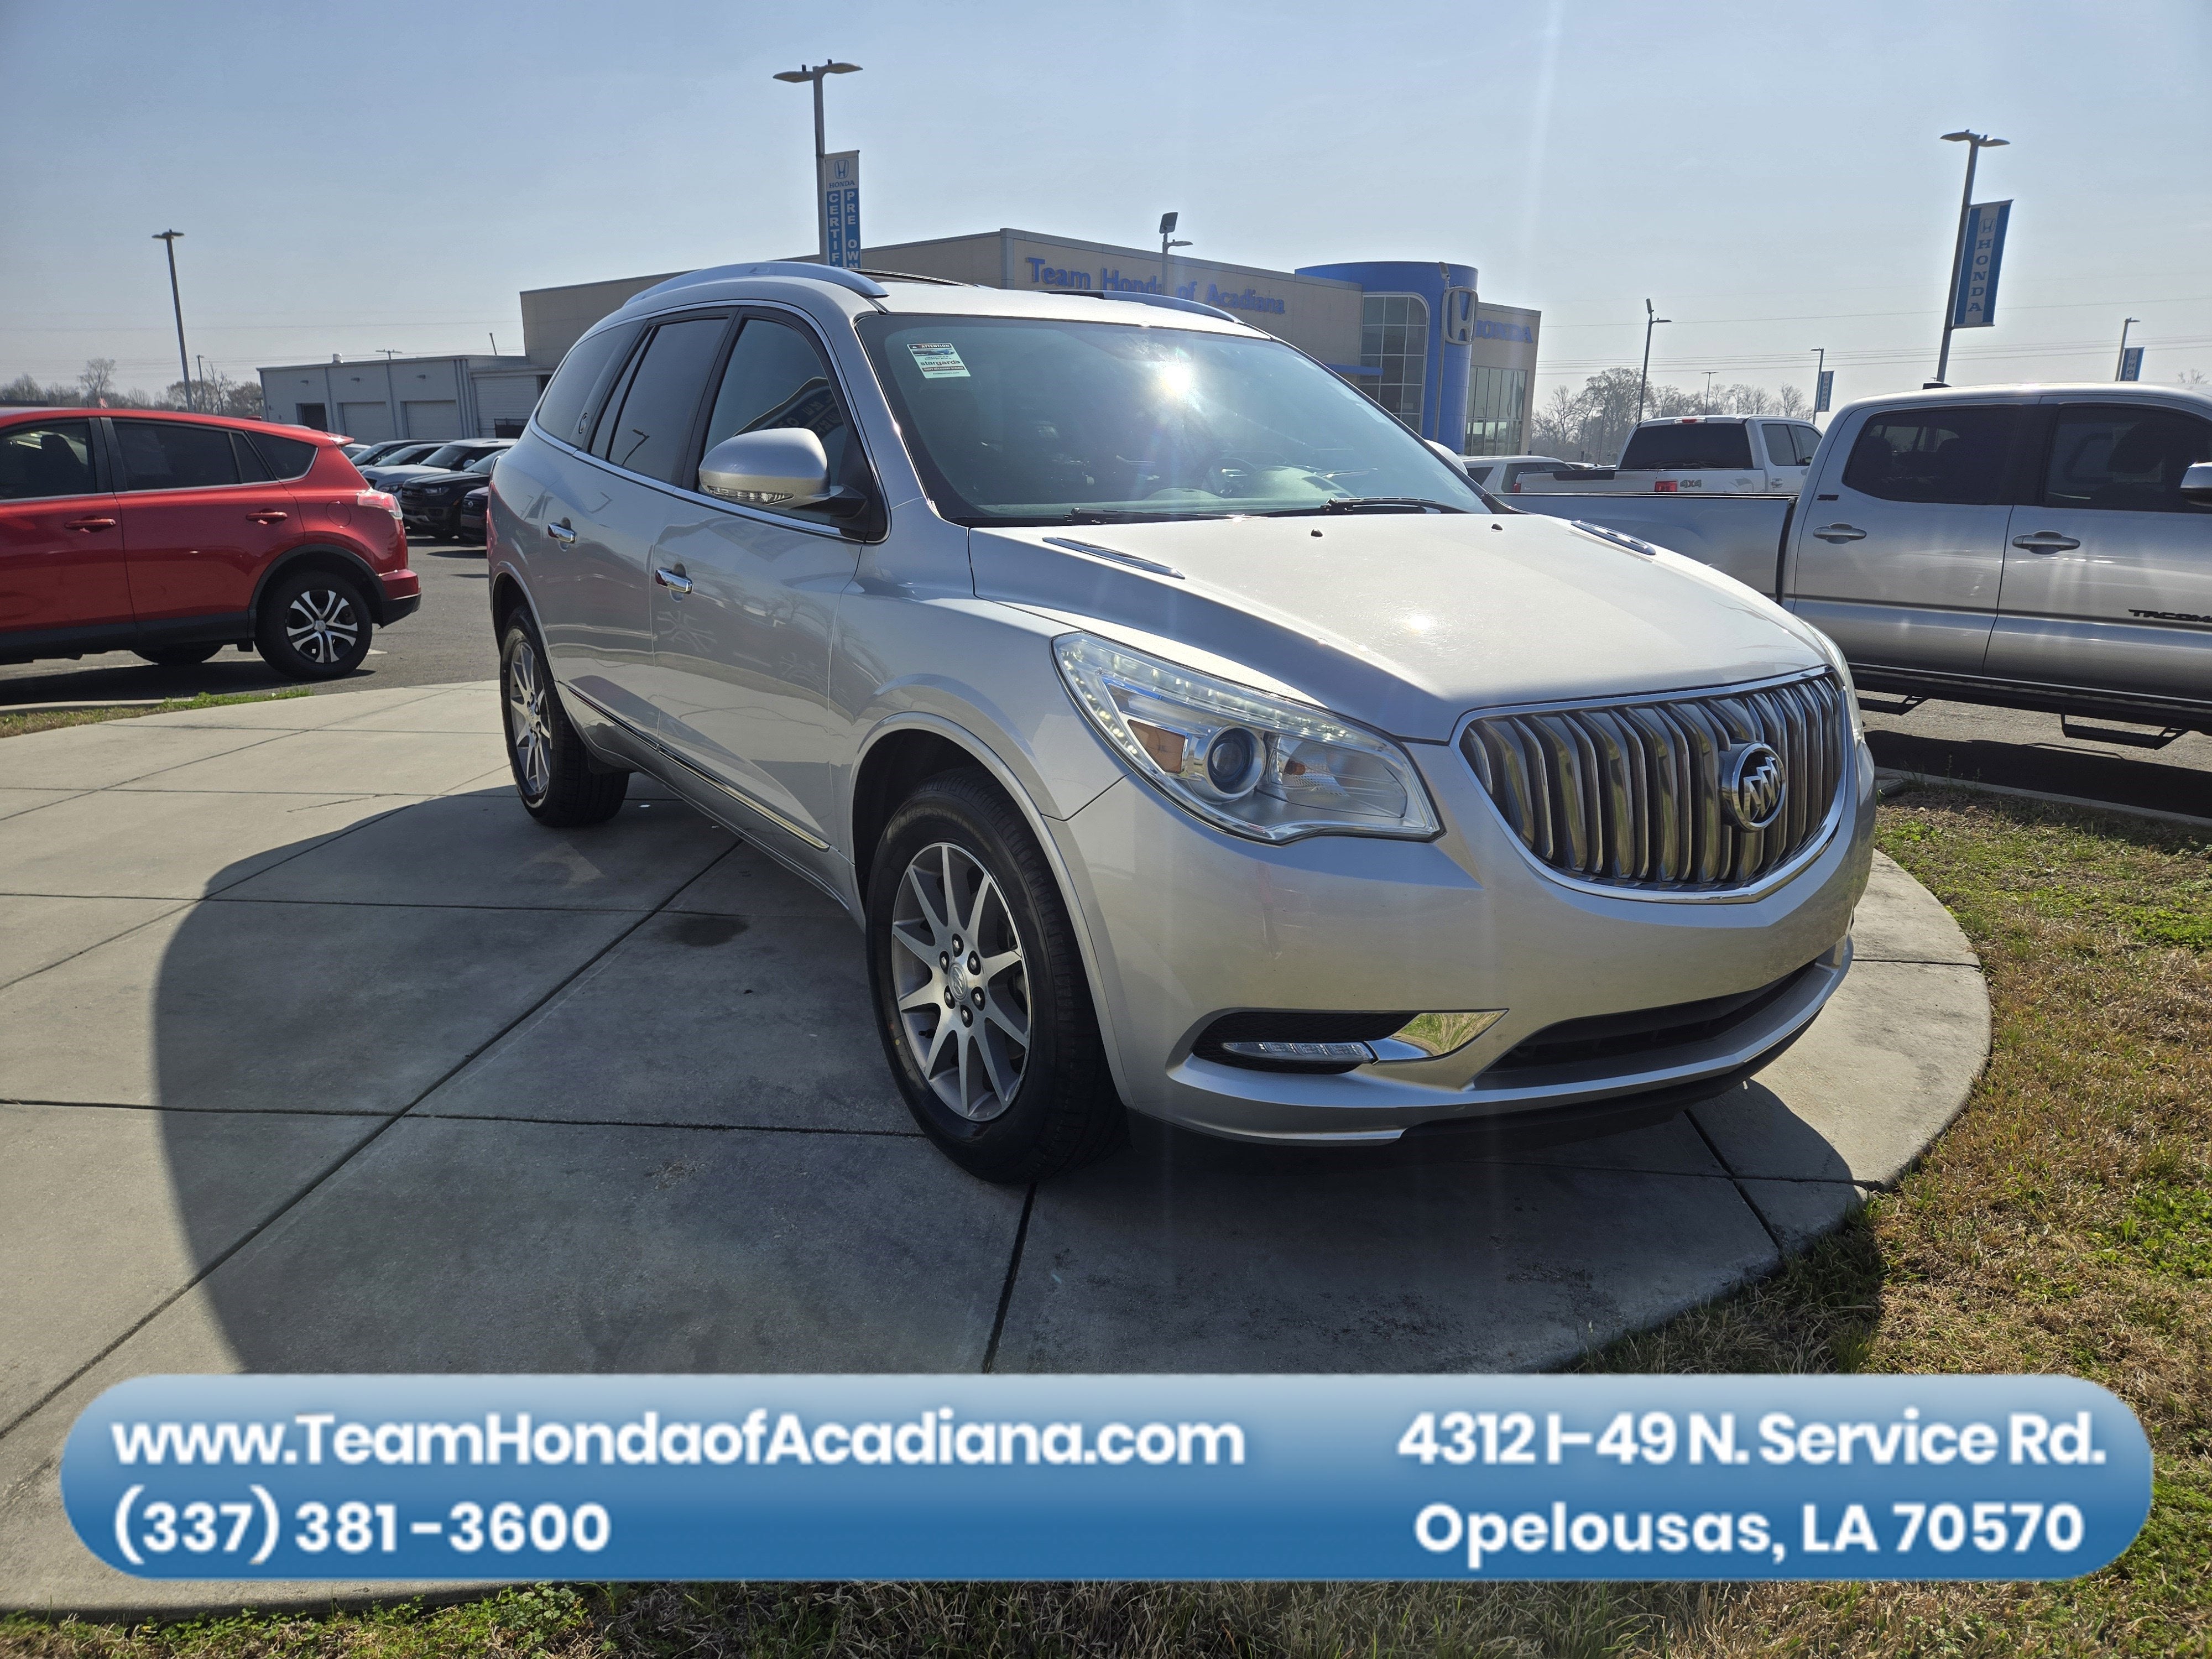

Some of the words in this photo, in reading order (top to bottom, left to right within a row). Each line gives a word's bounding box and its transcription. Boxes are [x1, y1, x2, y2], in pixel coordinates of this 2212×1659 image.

[829, 180, 855, 189] HONDA
[829, 193, 840, 267] CERTIF
[847, 191, 855, 225] PRE
[1026, 257, 1091, 290] Team
[1176, 281, 1197, 301] of
[1206, 283, 1286, 314] Acadiana
[1968, 239, 1992, 312] HONDA
[2128, 609, 2212, 623] TACOM
